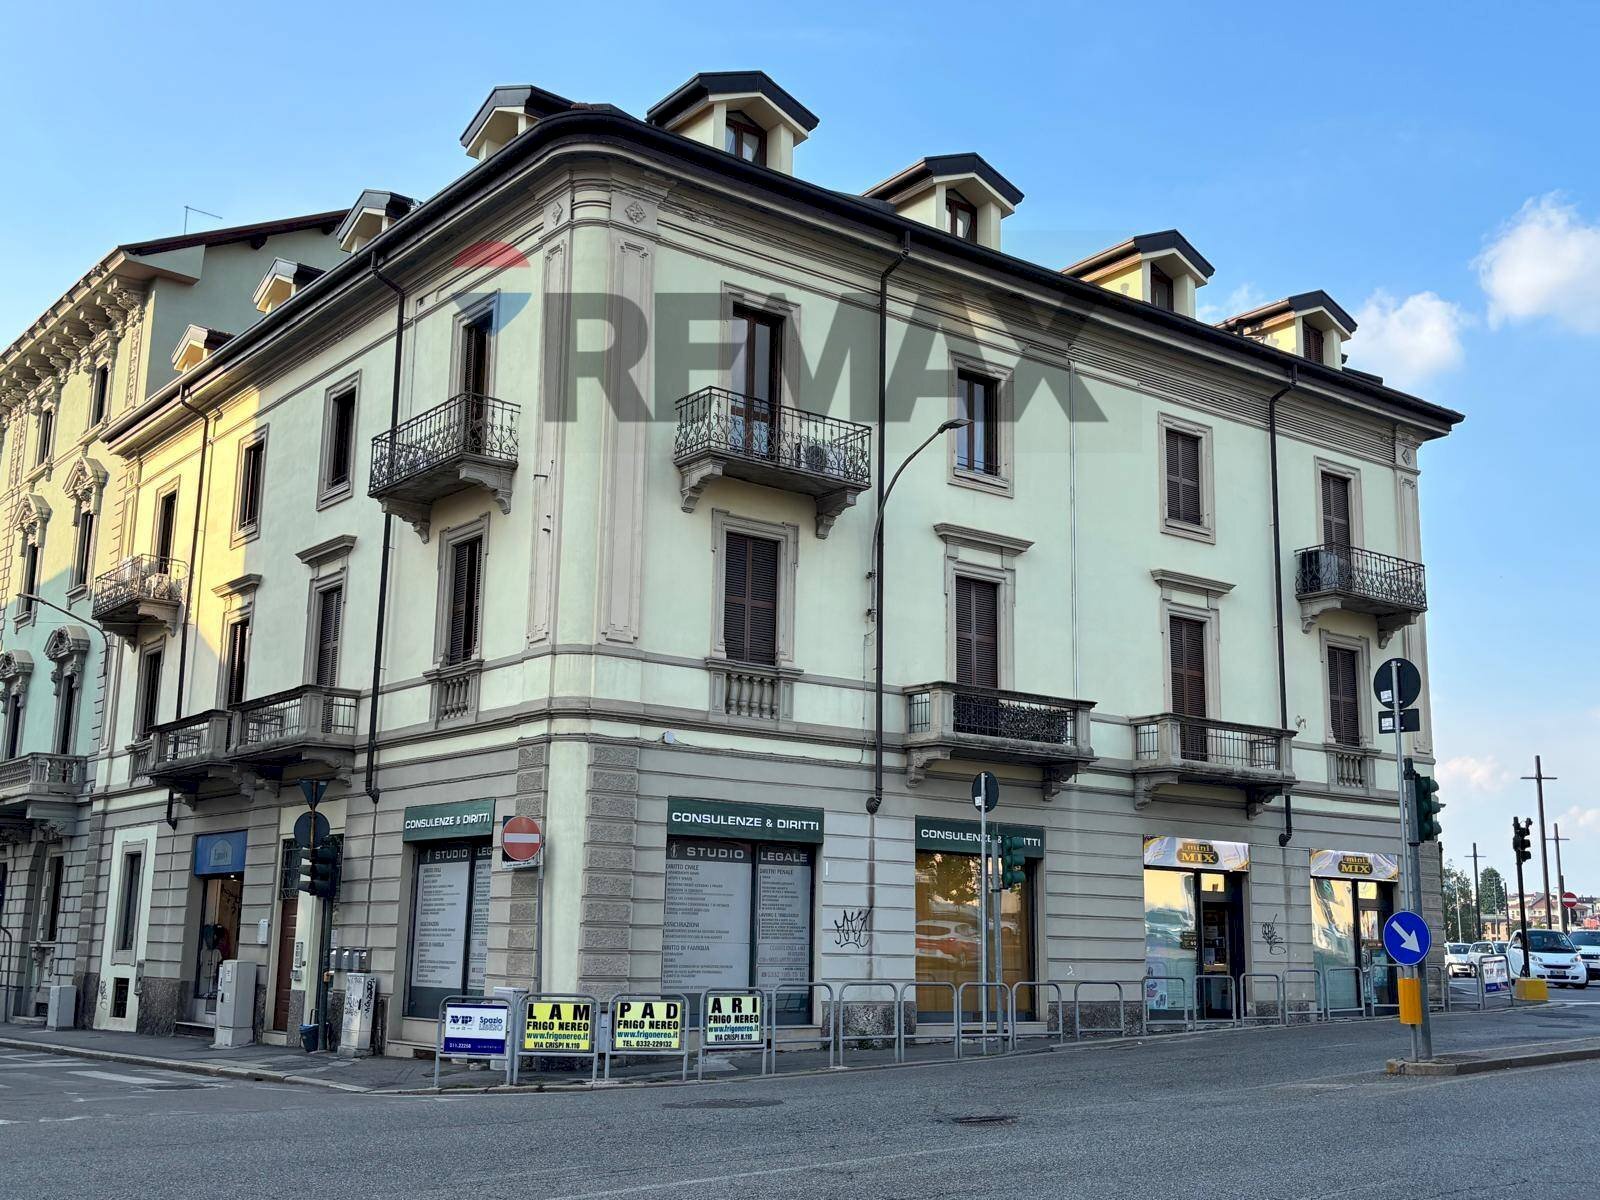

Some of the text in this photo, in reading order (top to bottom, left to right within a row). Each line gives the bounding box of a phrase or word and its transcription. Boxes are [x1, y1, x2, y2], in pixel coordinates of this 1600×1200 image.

[405, 812, 490, 829] CONSULENZE & DIRITTI
[671, 812, 819, 831] CONSULENZE & DIRITTI
[1187, 843, 1210, 852] mini
[435, 848, 468, 860] STUDIO
[686, 846, 808, 862] STUDIO LEGALE
[1181, 852, 1215, 864] MIX
[1344, 856, 1366, 864] mini
[1340, 863, 1370, 873] MIX
[479, 1016, 503, 1025] Spazio
[708, 1014, 759, 1024] FRIGO NEREO
[526, 1021, 589, 1032] FRIGO NEREO
[617, 1020, 679, 1030] FRIGO NEREO
[526, 1031, 588, 1041] www.frigonereo.it
[617, 1030, 678, 1040] www.frigonereo.it
[545, 1041, 564, 1049] CRISPI
